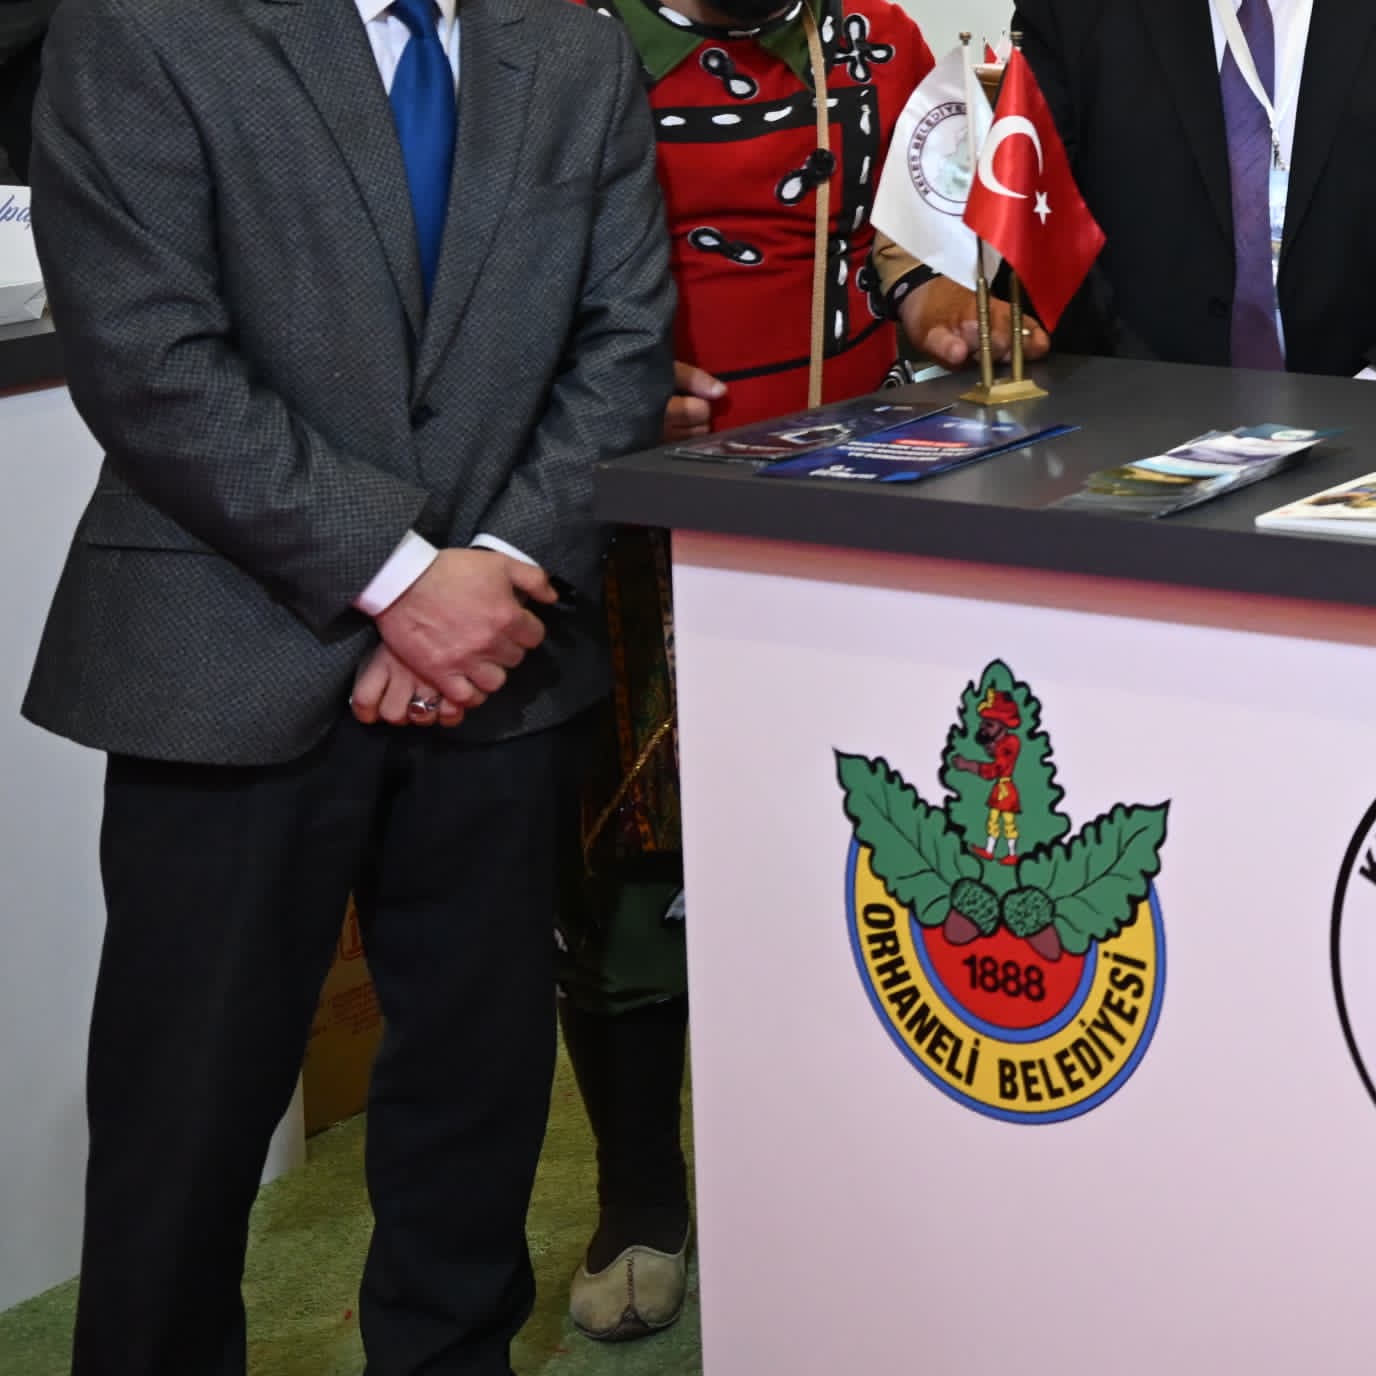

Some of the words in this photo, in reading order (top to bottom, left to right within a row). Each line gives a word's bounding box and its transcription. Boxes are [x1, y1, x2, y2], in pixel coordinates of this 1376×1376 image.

[863, 901, 982, 1086] ORHANELİ
[998, 951, 1148, 1102] BELEDİYESİ
[962, 953, 1046, 1003] 1888
